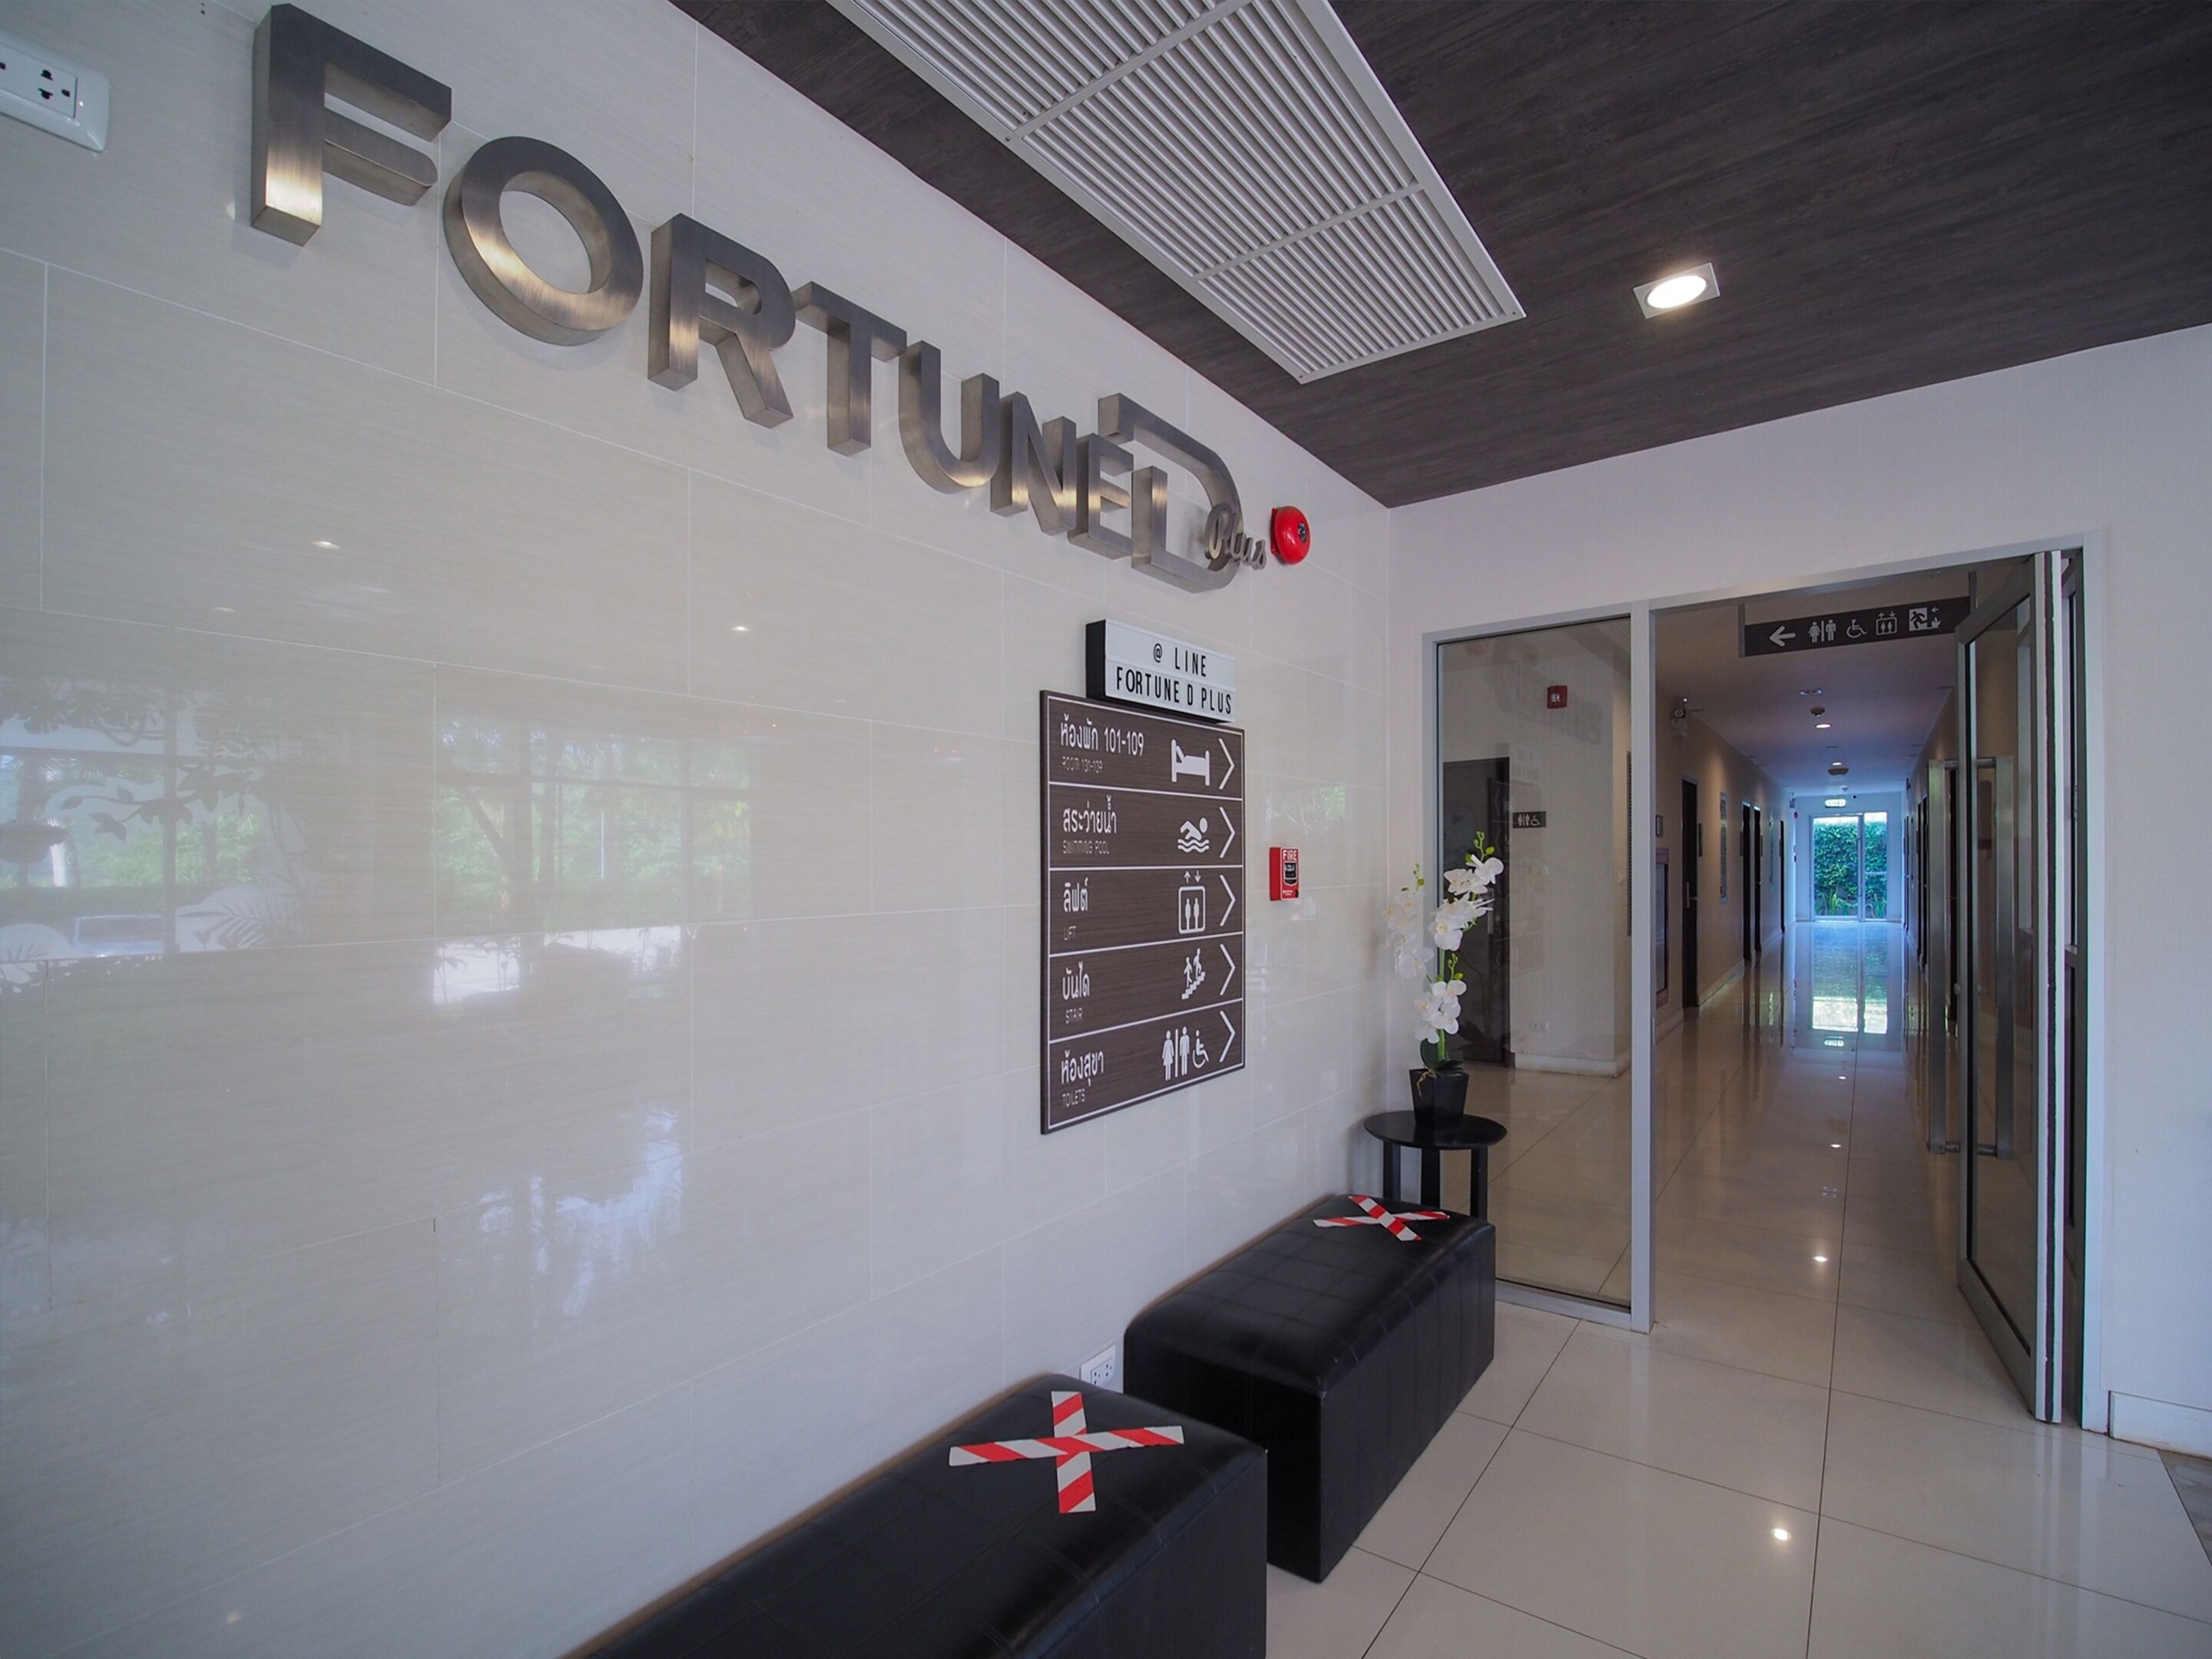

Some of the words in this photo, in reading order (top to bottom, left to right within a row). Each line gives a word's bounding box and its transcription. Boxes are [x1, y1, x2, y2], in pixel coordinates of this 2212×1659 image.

[250, 2, 1135, 559] FORTUNE
[1098, 392, 1243, 594] D
[1153, 643, 1163, 663] @
[1174, 647, 1207, 677] LINE
[1116, 666, 1180, 704] FORTUNE
[1187, 684, 1194, 706] D
[1201, 687, 1231, 714] PLUS
[1061, 713, 1098, 750] ห้องพัก
[1104, 727, 1144, 757] 101-109
[1063, 794, 1117, 833] สระว่ายน้ำ
[1283, 849, 1297, 861] FIRE
[1064, 877, 1088, 912] ลิฟต์
[1062, 961, 1090, 1000] บันได
[1061, 1049, 1104, 1086] ห้องสุขา
